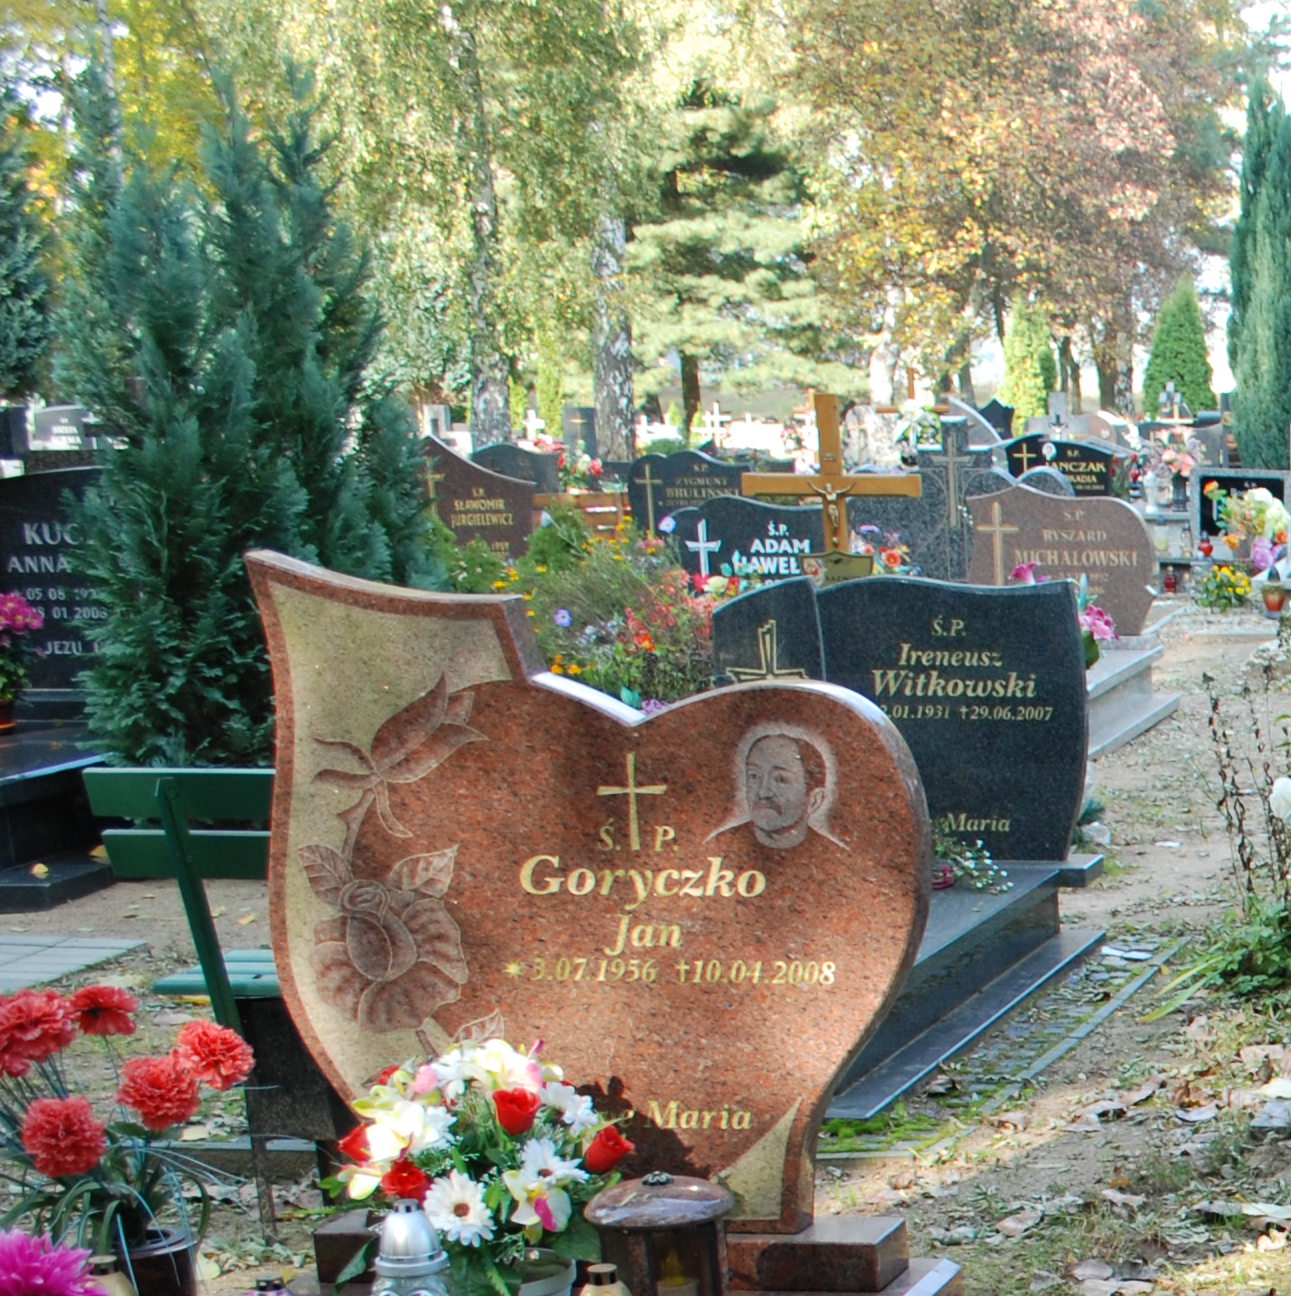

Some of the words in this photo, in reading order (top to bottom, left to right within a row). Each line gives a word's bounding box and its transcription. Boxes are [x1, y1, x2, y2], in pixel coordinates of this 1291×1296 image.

[750, 538, 811, 554] ADAM
[1042, 529, 1107, 541] RYSZARD
[897, 642, 1004, 668] Ireneusz
[871, 669, 1038, 699] Witkowski
[969, 704, 1054, 721] 29.06.2007
[946, 812, 1011, 833] Maria
[519, 854, 767, 910] Goryczko
[603, 913, 684, 957] Jan
[692, 960, 837, 985] 10.04.2008
[646, 1099, 752, 1131] Maria
